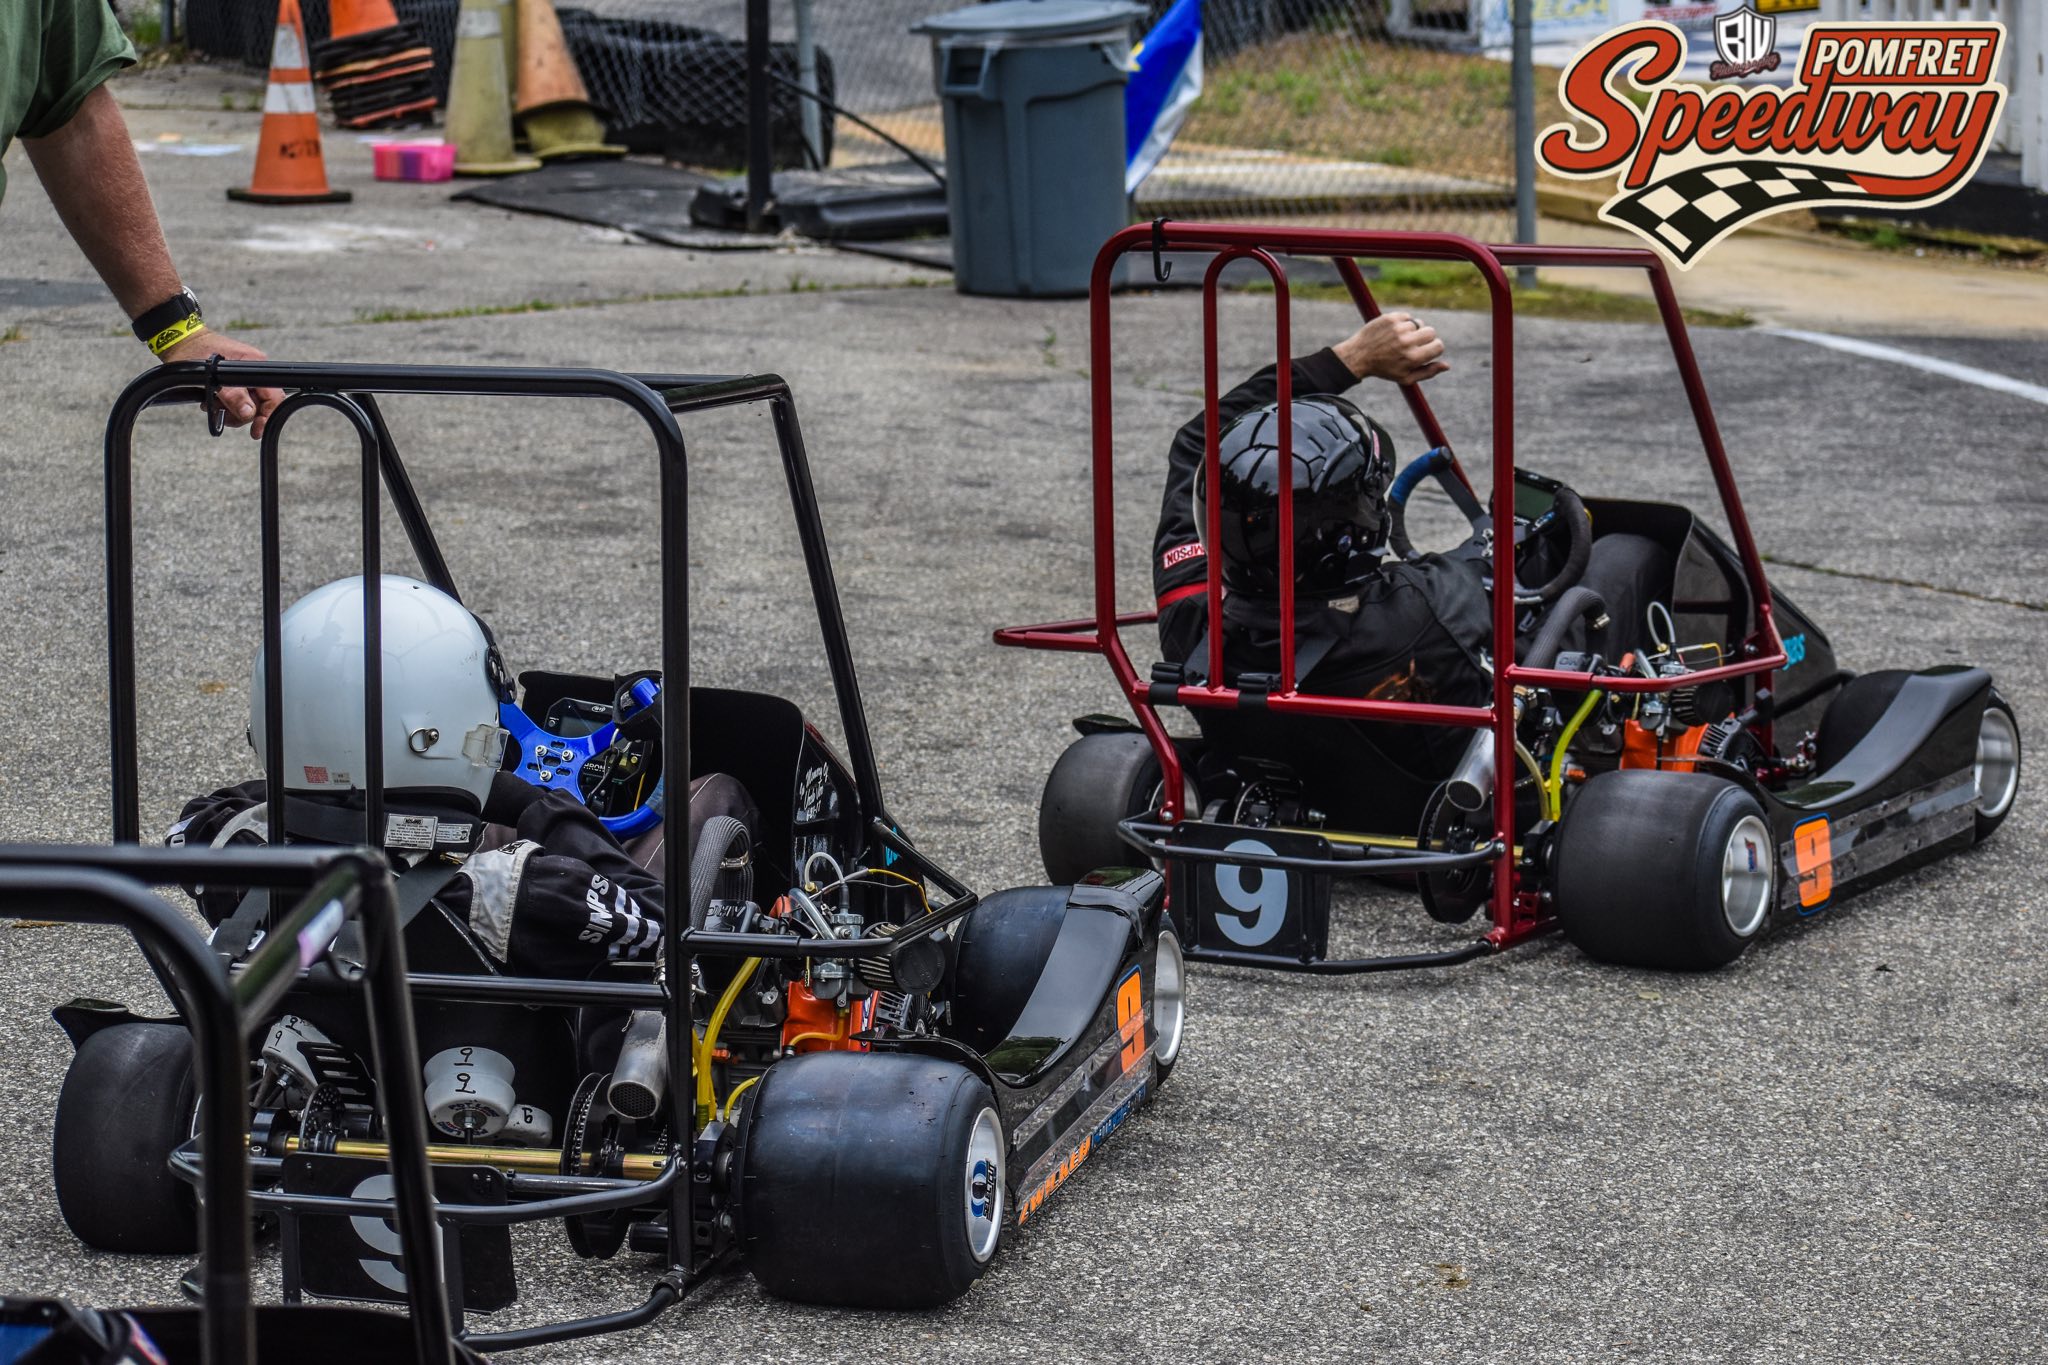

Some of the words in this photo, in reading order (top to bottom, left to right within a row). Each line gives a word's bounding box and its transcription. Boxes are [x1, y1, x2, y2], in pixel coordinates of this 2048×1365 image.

[1166, 545, 1205, 566] MPSON
[578, 874, 610, 944] SIMPS
[1214, 838, 1289, 947] 9
[1793, 815, 1834, 911] 9
[1115, 966, 1147, 1078] 9
